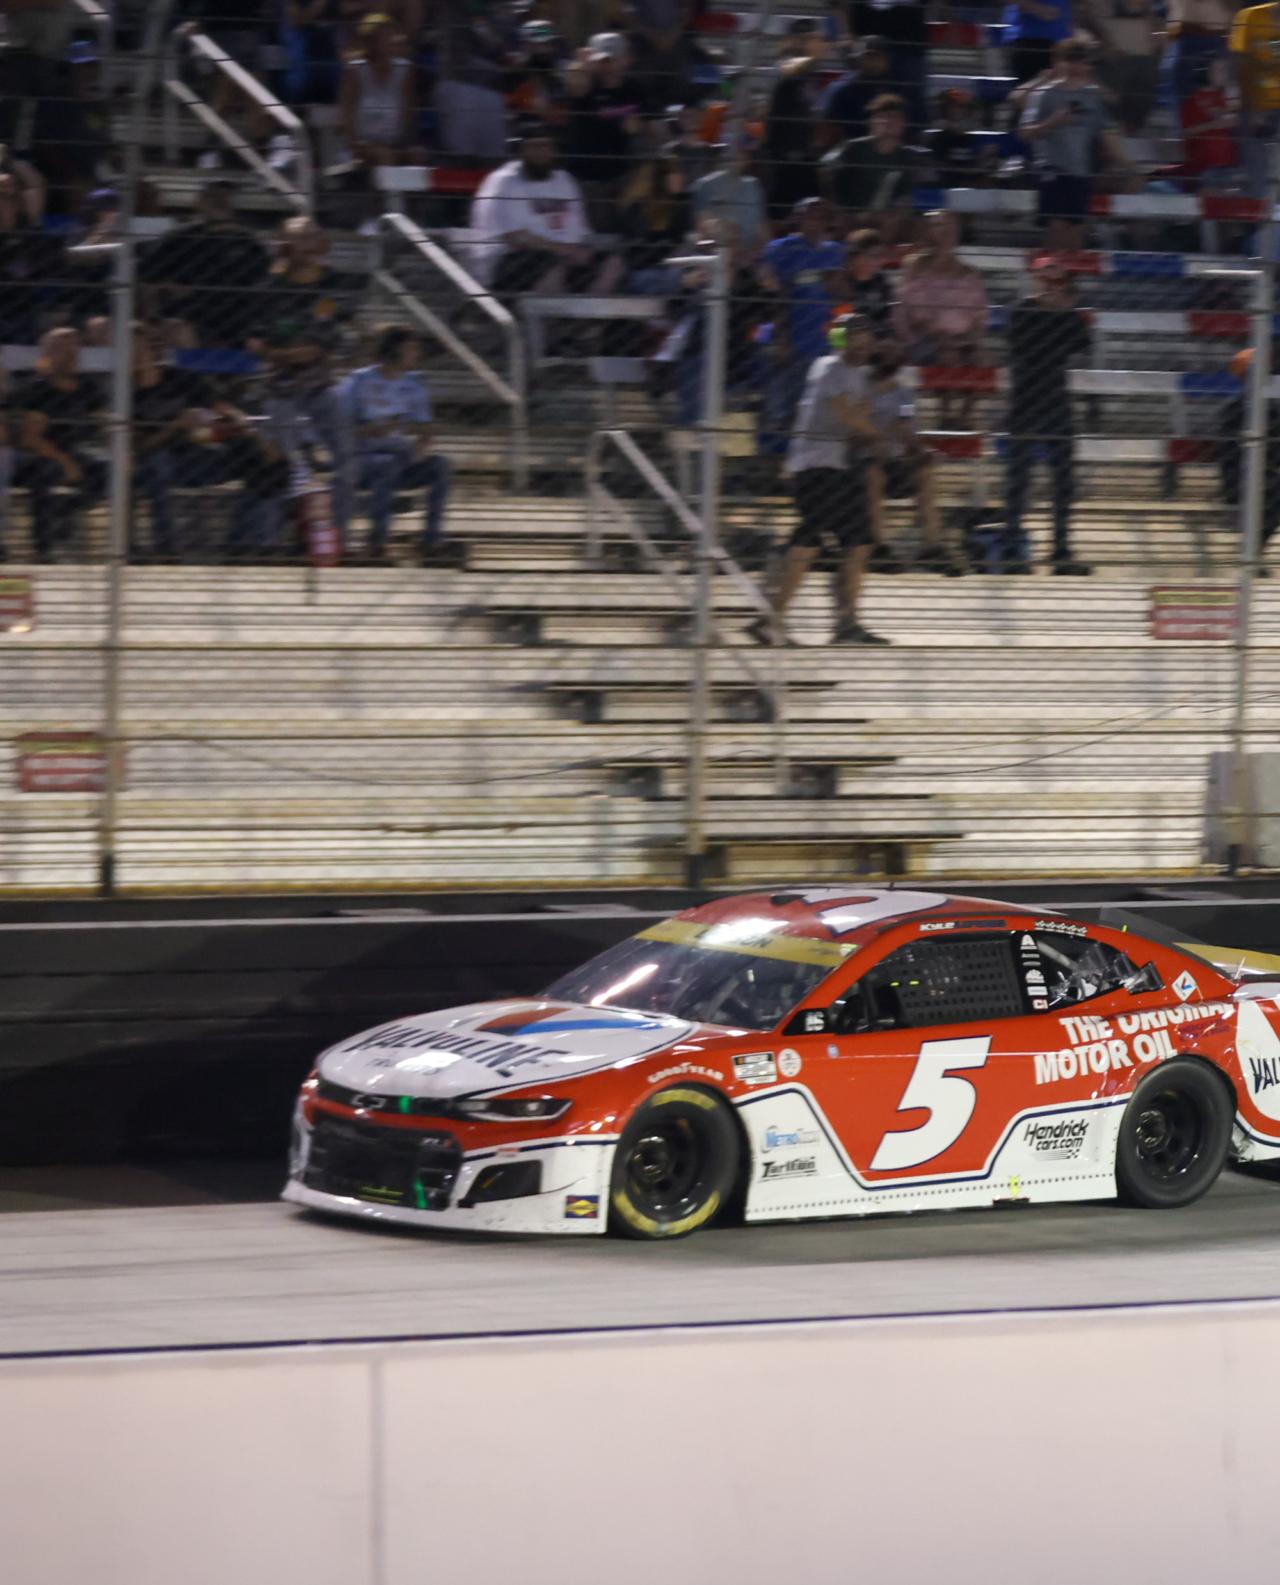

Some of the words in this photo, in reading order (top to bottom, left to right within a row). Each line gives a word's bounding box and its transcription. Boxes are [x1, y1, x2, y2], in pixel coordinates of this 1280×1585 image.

[920, 922, 955, 931] KYLE
[1059, 1014, 1114, 1044] THE
[342, 1025, 572, 1078] VALVOLINE
[1034, 1038, 1134, 1085] MOTOR
[1132, 1030, 1178, 1063] OIL
[869, 1035, 993, 1172] 5
[1023, 1118, 1090, 1147] Hendrick
